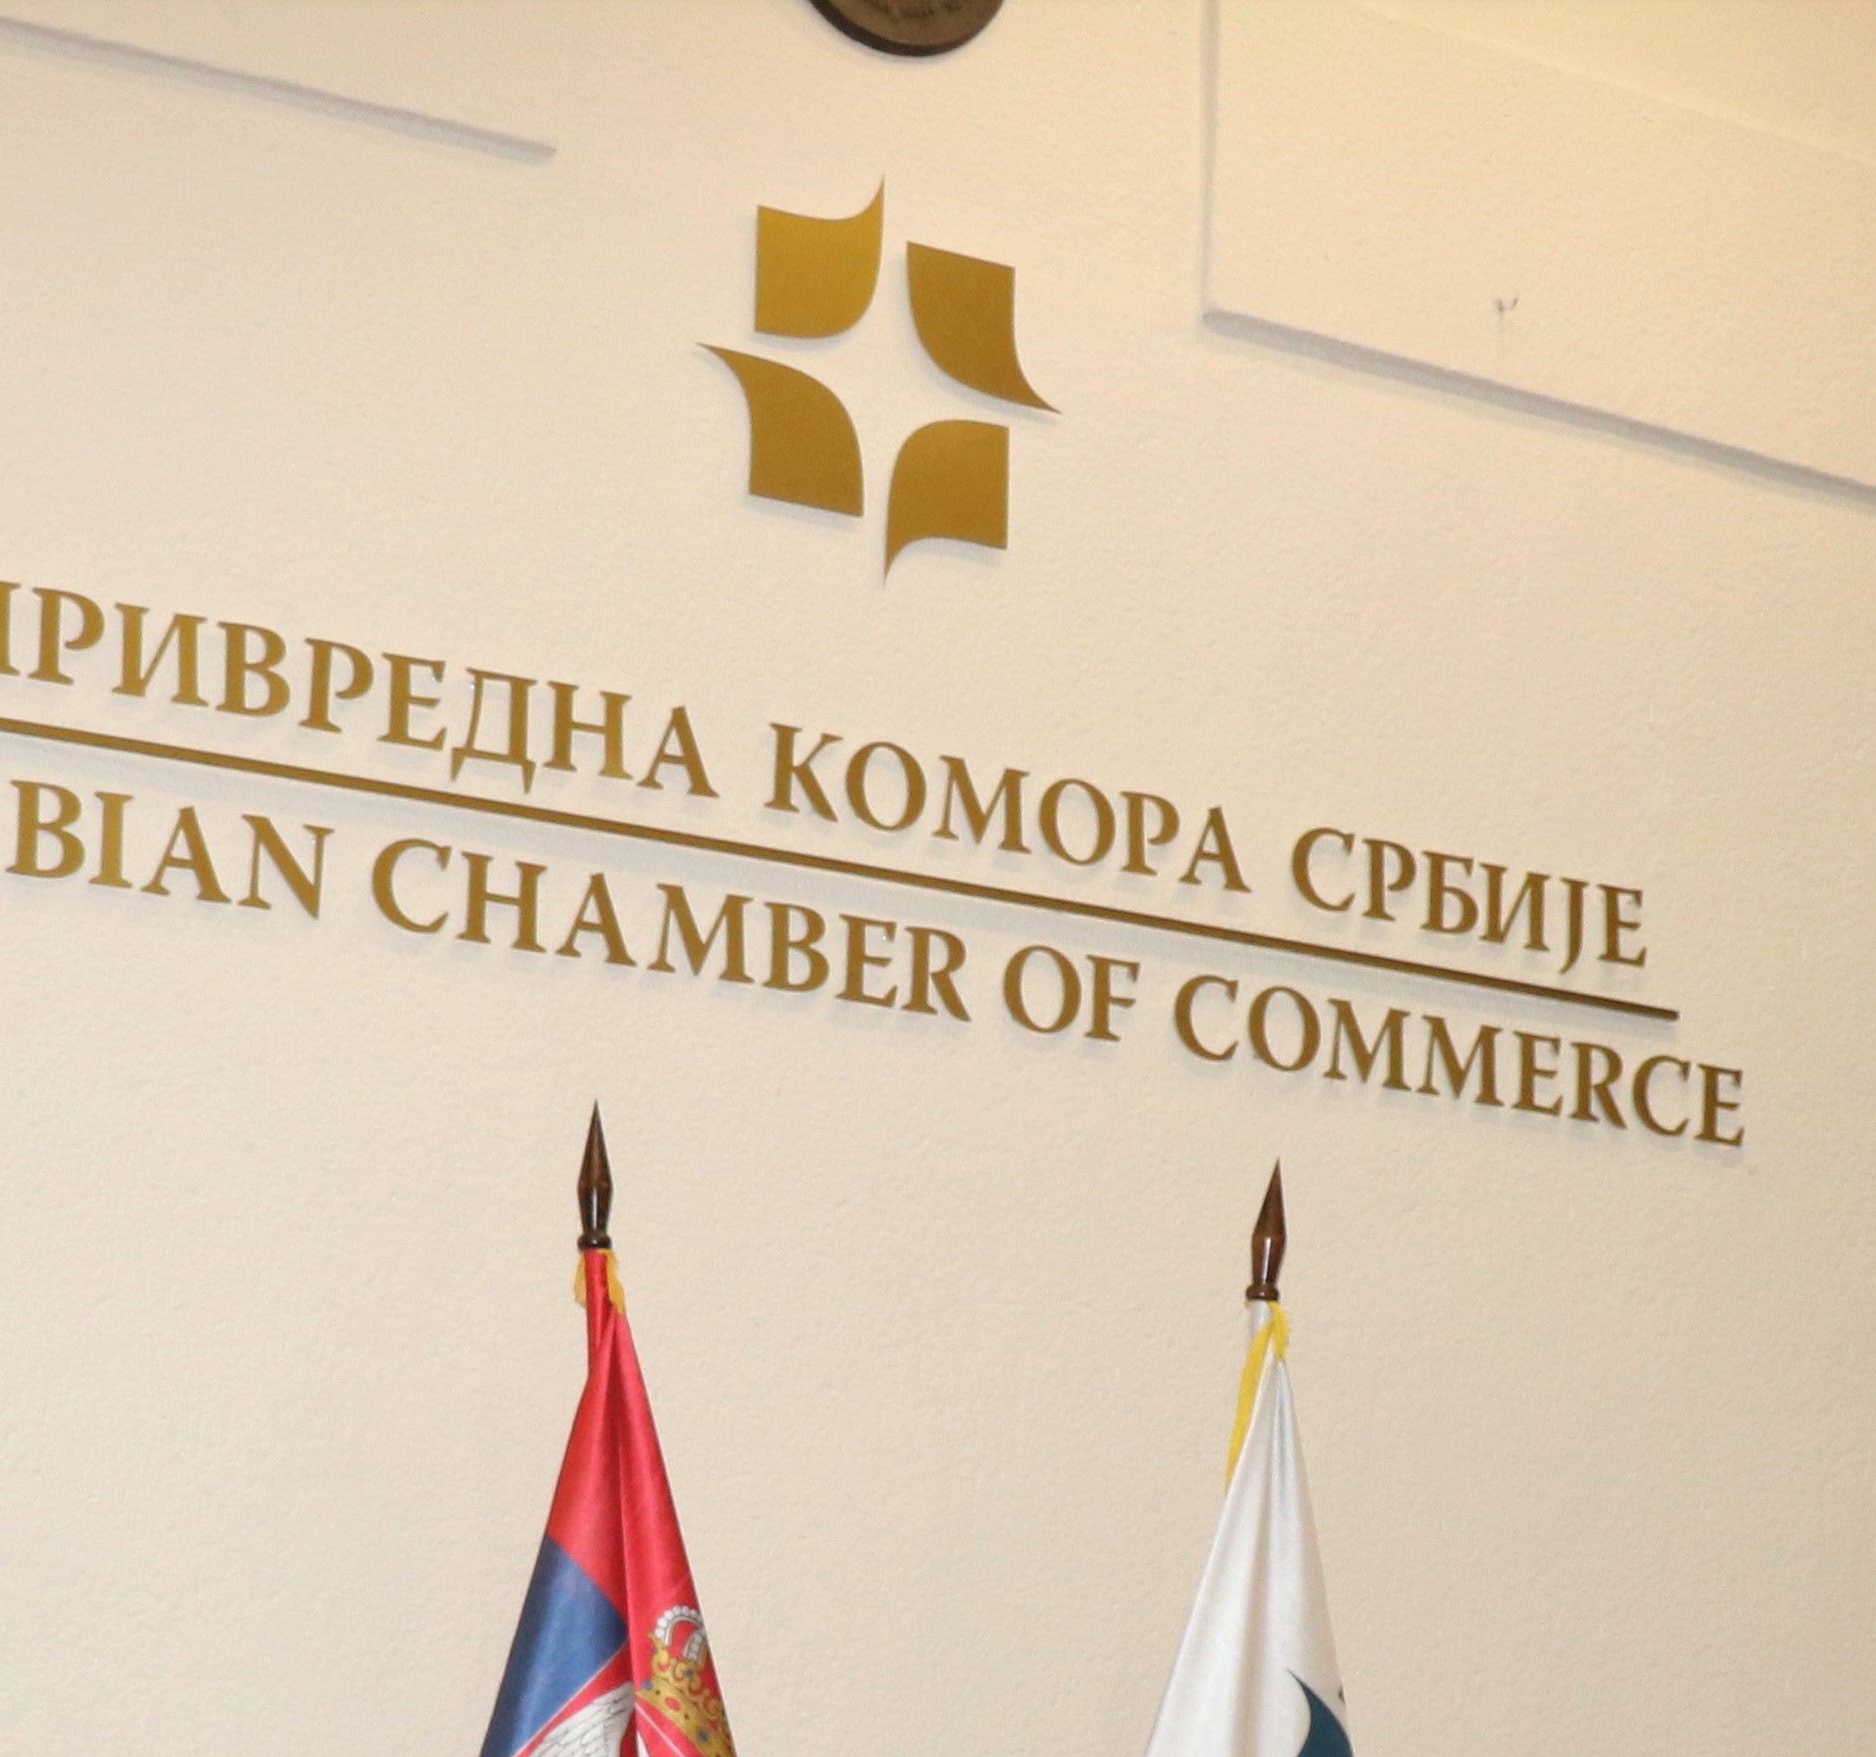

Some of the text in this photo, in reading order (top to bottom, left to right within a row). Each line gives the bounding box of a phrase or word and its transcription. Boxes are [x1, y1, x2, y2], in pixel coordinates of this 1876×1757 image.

[763, 722, 1249, 892] КОМОРА
[1288, 826, 1647, 974] СРБИЈЕ
[369, 837, 969, 1022] CHAMBER
[1001, 944, 1140, 1041] OF
[1172, 974, 1744, 1147] COMMERCE
